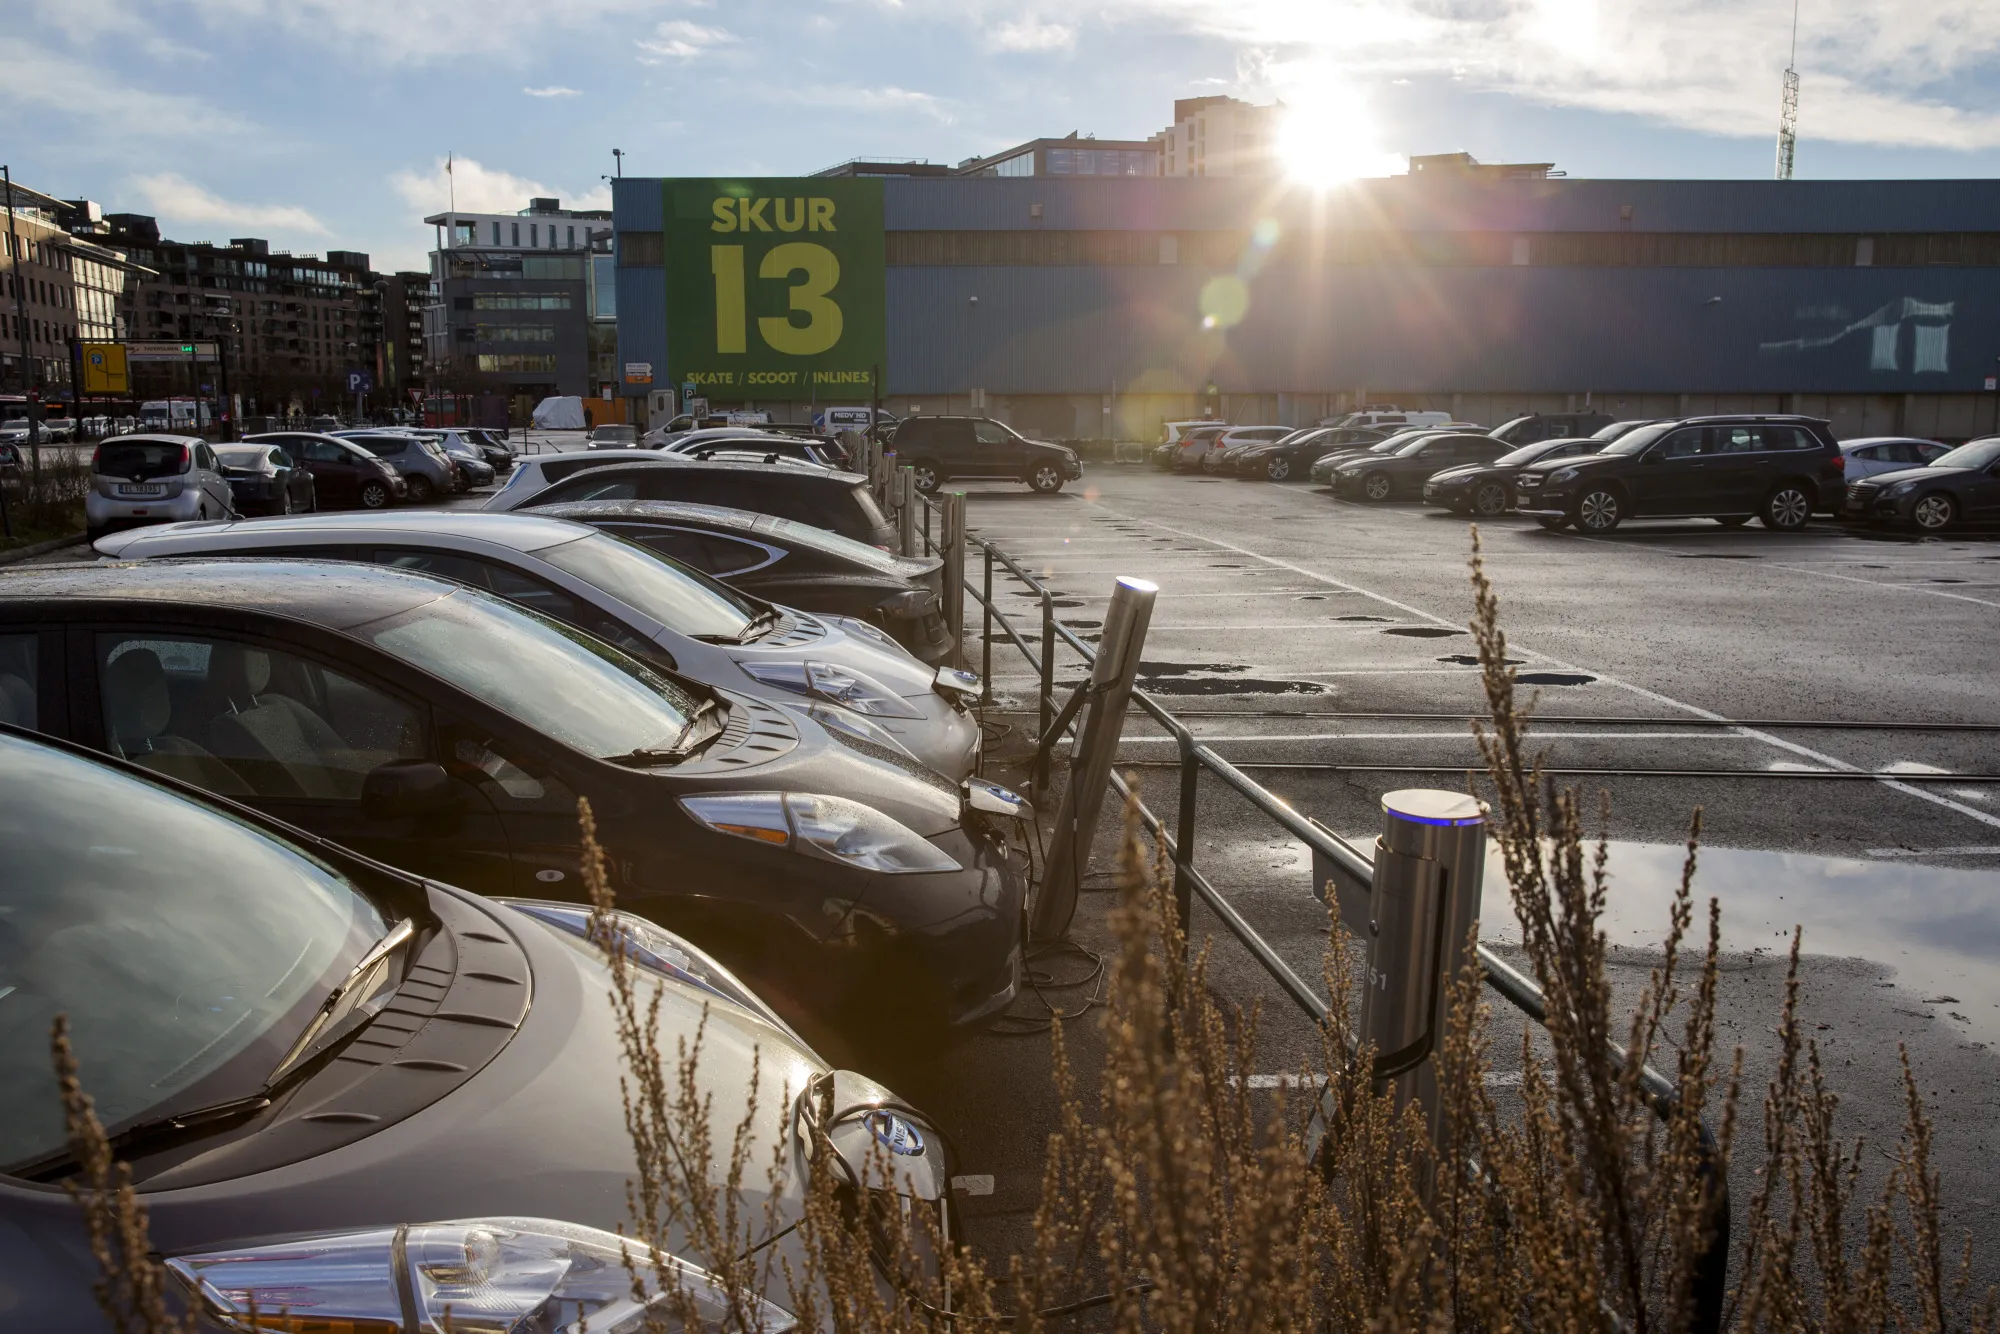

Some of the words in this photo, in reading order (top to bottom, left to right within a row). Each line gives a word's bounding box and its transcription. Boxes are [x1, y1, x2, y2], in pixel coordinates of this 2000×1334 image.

[710, 197, 838, 233] SKUR
[711, 241, 843, 356] 13
[349, 374, 361, 390] P
[686, 372, 733, 385] SKATE
[747, 372, 798, 384] SCOOT
[813, 371, 870, 384] INLINES
[686, 389, 693, 399] P
